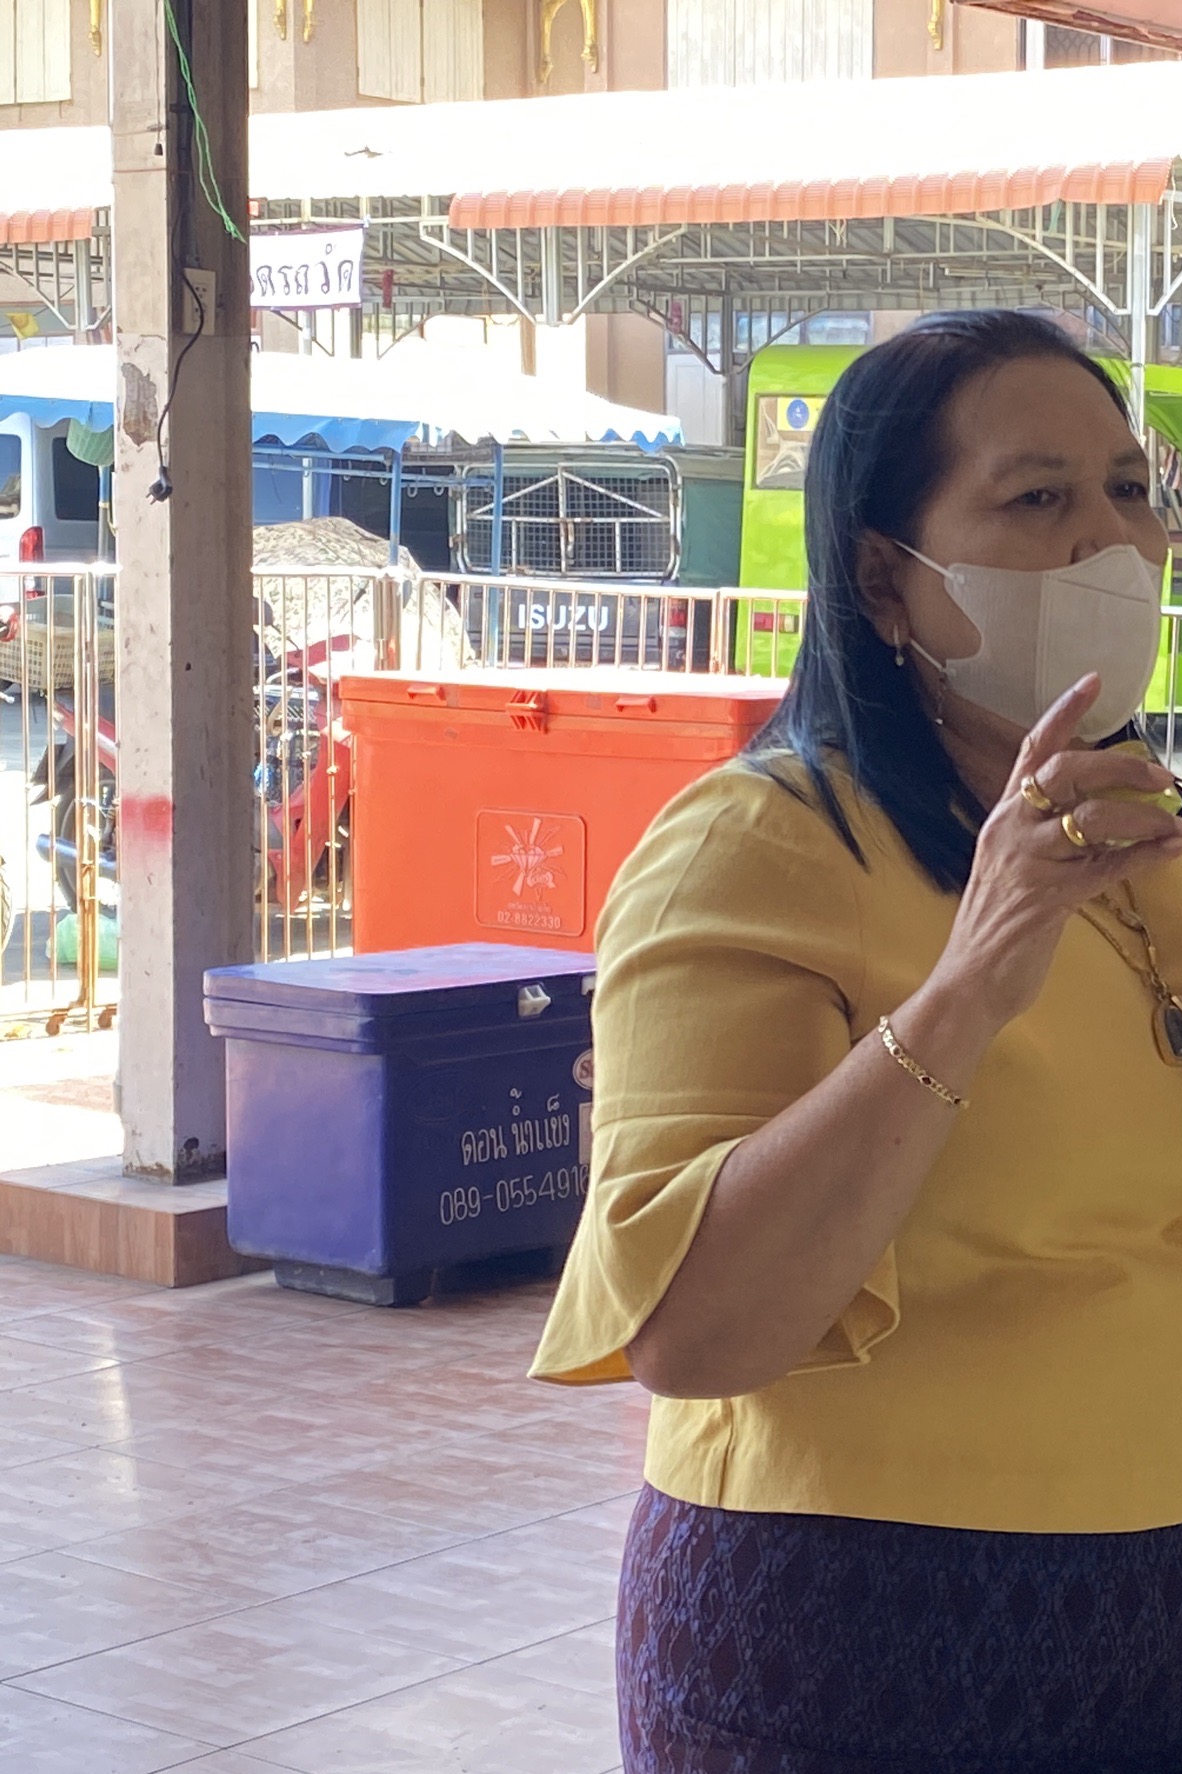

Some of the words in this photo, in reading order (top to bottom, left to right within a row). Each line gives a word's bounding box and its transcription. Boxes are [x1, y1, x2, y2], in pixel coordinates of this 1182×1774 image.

[250, 243, 354, 297] ดรถวัด
[518, 603, 609, 631] ISUZU
[579, 1060, 594, 1079] S
